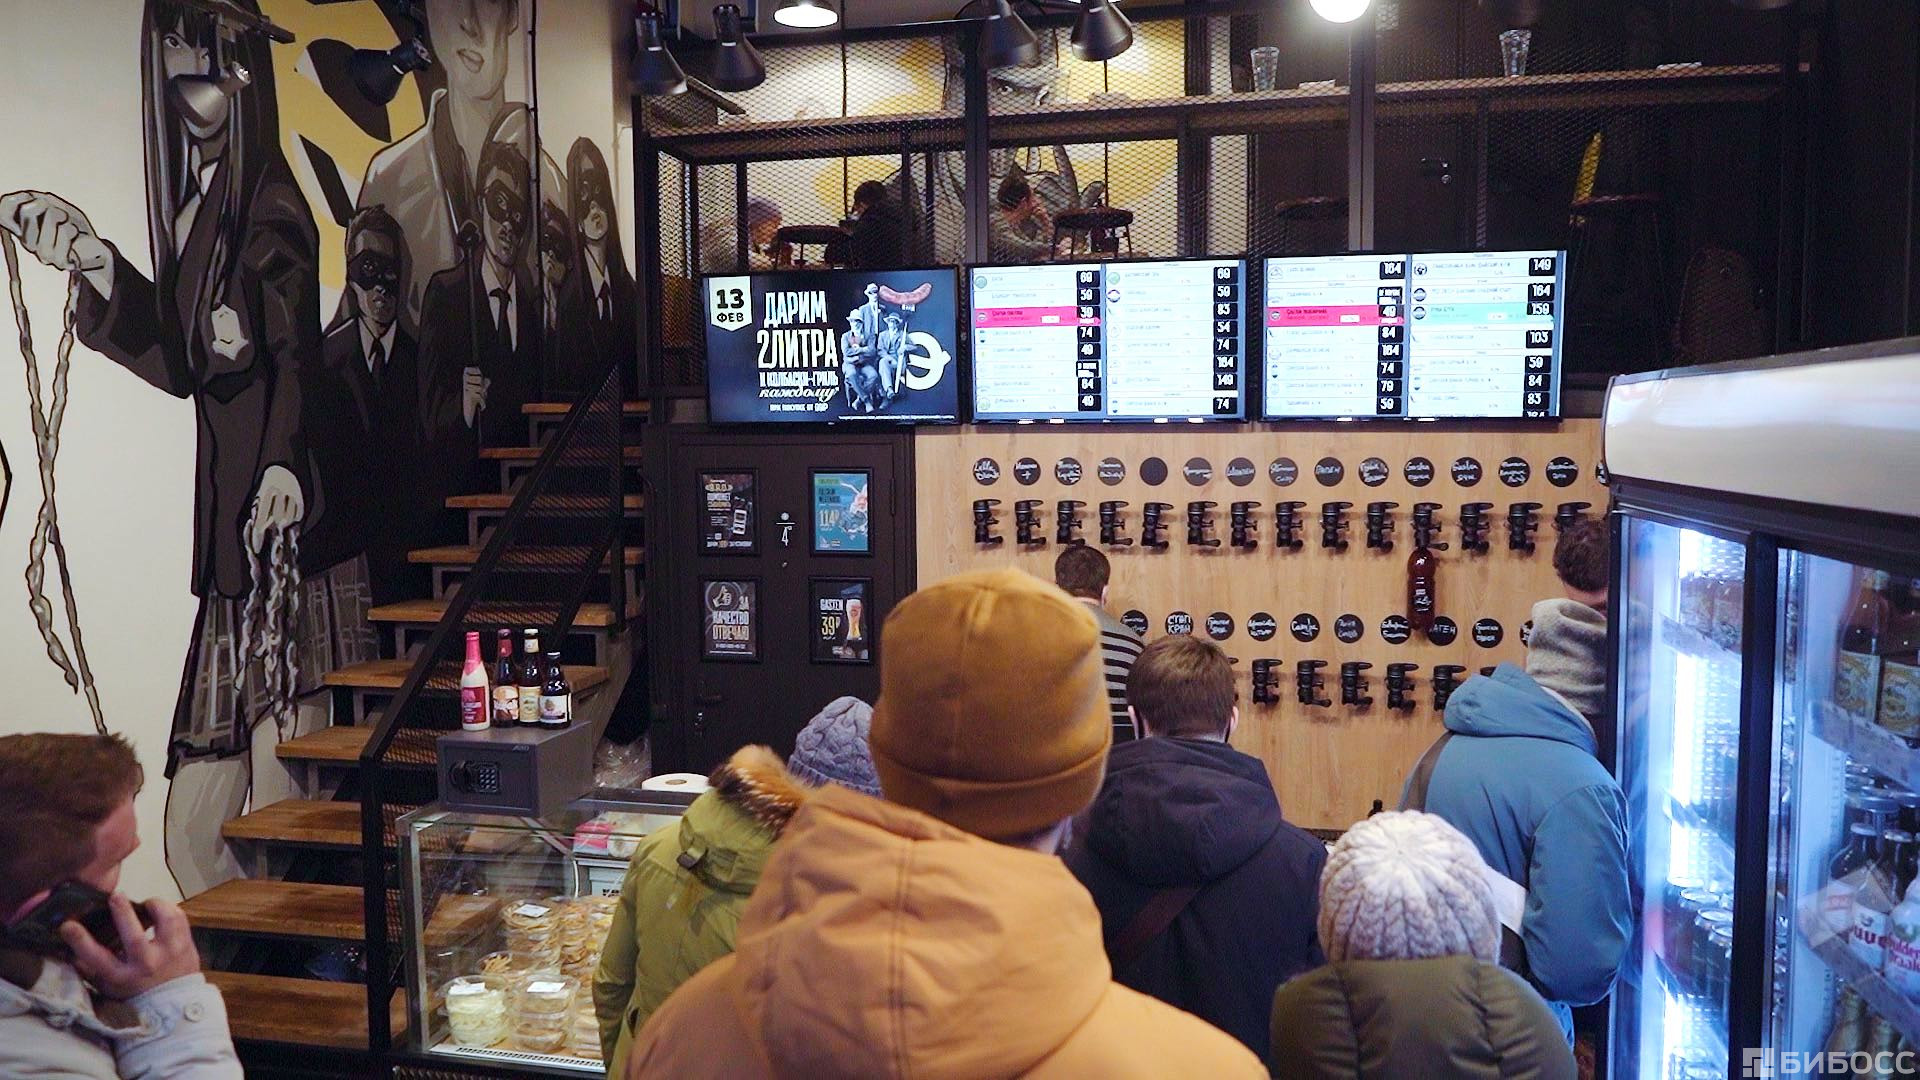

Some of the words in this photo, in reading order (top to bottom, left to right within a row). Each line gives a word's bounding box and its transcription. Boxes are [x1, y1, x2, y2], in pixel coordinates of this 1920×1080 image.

[1534, 259, 1551, 271] 149
[1533, 285, 1550, 296] 164
[717, 289, 744, 309] 13
[764, 291, 827, 328] ДАРИМ
[717, 313, 744, 322] ФЕВ
[1080, 327, 1093, 337] 74
[1217, 339, 1230, 350] 74
[1381, 362, 1394, 373] 74
[1217, 399, 1229, 409] 74
[739, 596, 749, 610] ЗА
[712, 610, 749, 624] КАЧЕСТВО
[712, 625, 749, 640] ОТВЕЧАЮ
